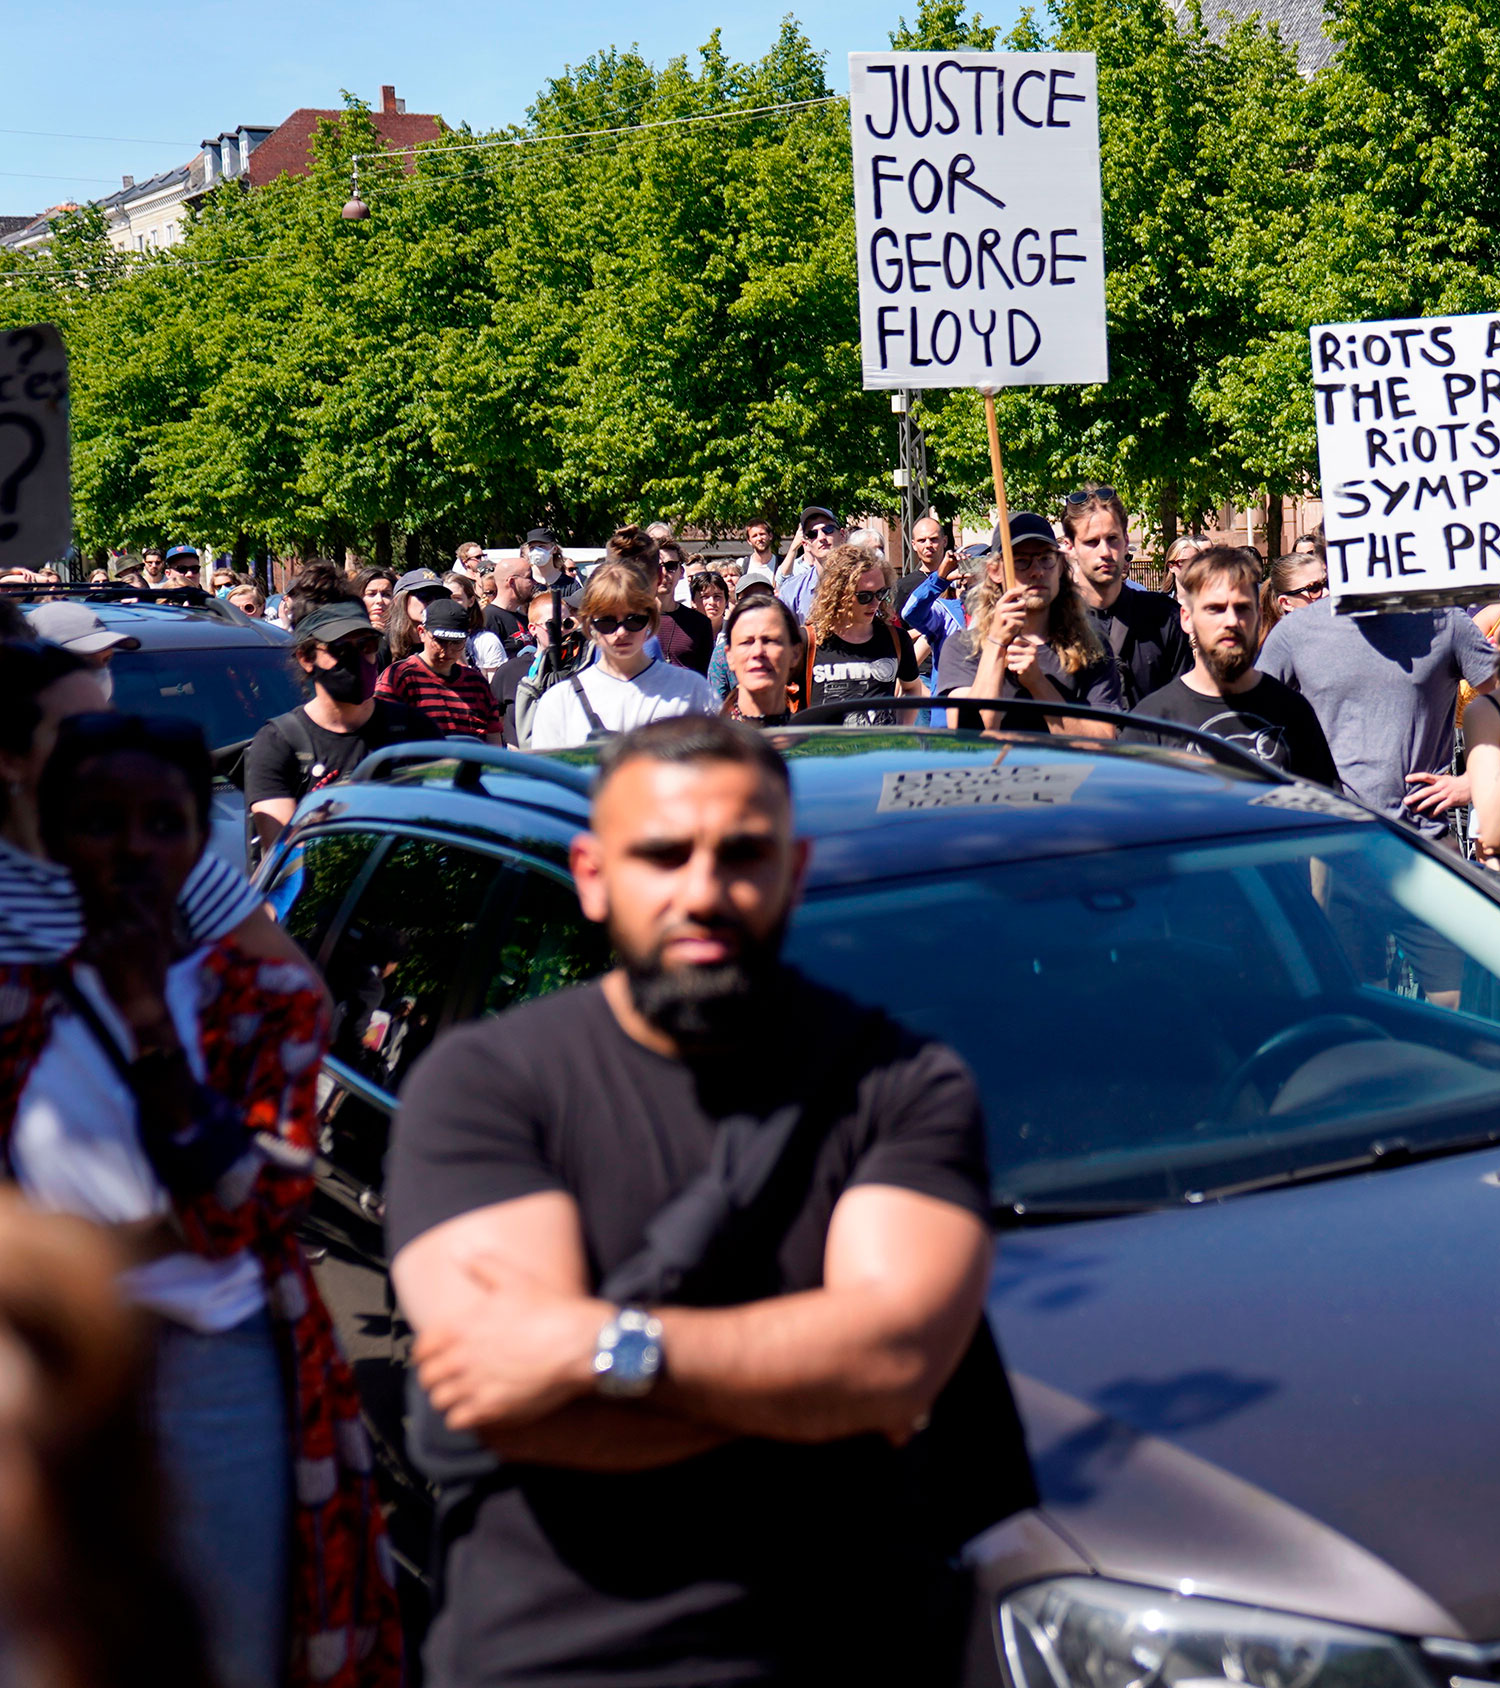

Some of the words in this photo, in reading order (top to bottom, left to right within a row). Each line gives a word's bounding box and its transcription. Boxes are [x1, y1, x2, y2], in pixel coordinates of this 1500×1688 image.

[865, 60, 1086, 139] JUSTICE
[872, 153, 1006, 219] FOR
[871, 227, 1087, 294] GEORGE
[878, 306, 1041, 370] FLOYD
[1315, 376, 1417, 425] THE
[1327, 532, 1426, 583] THE
